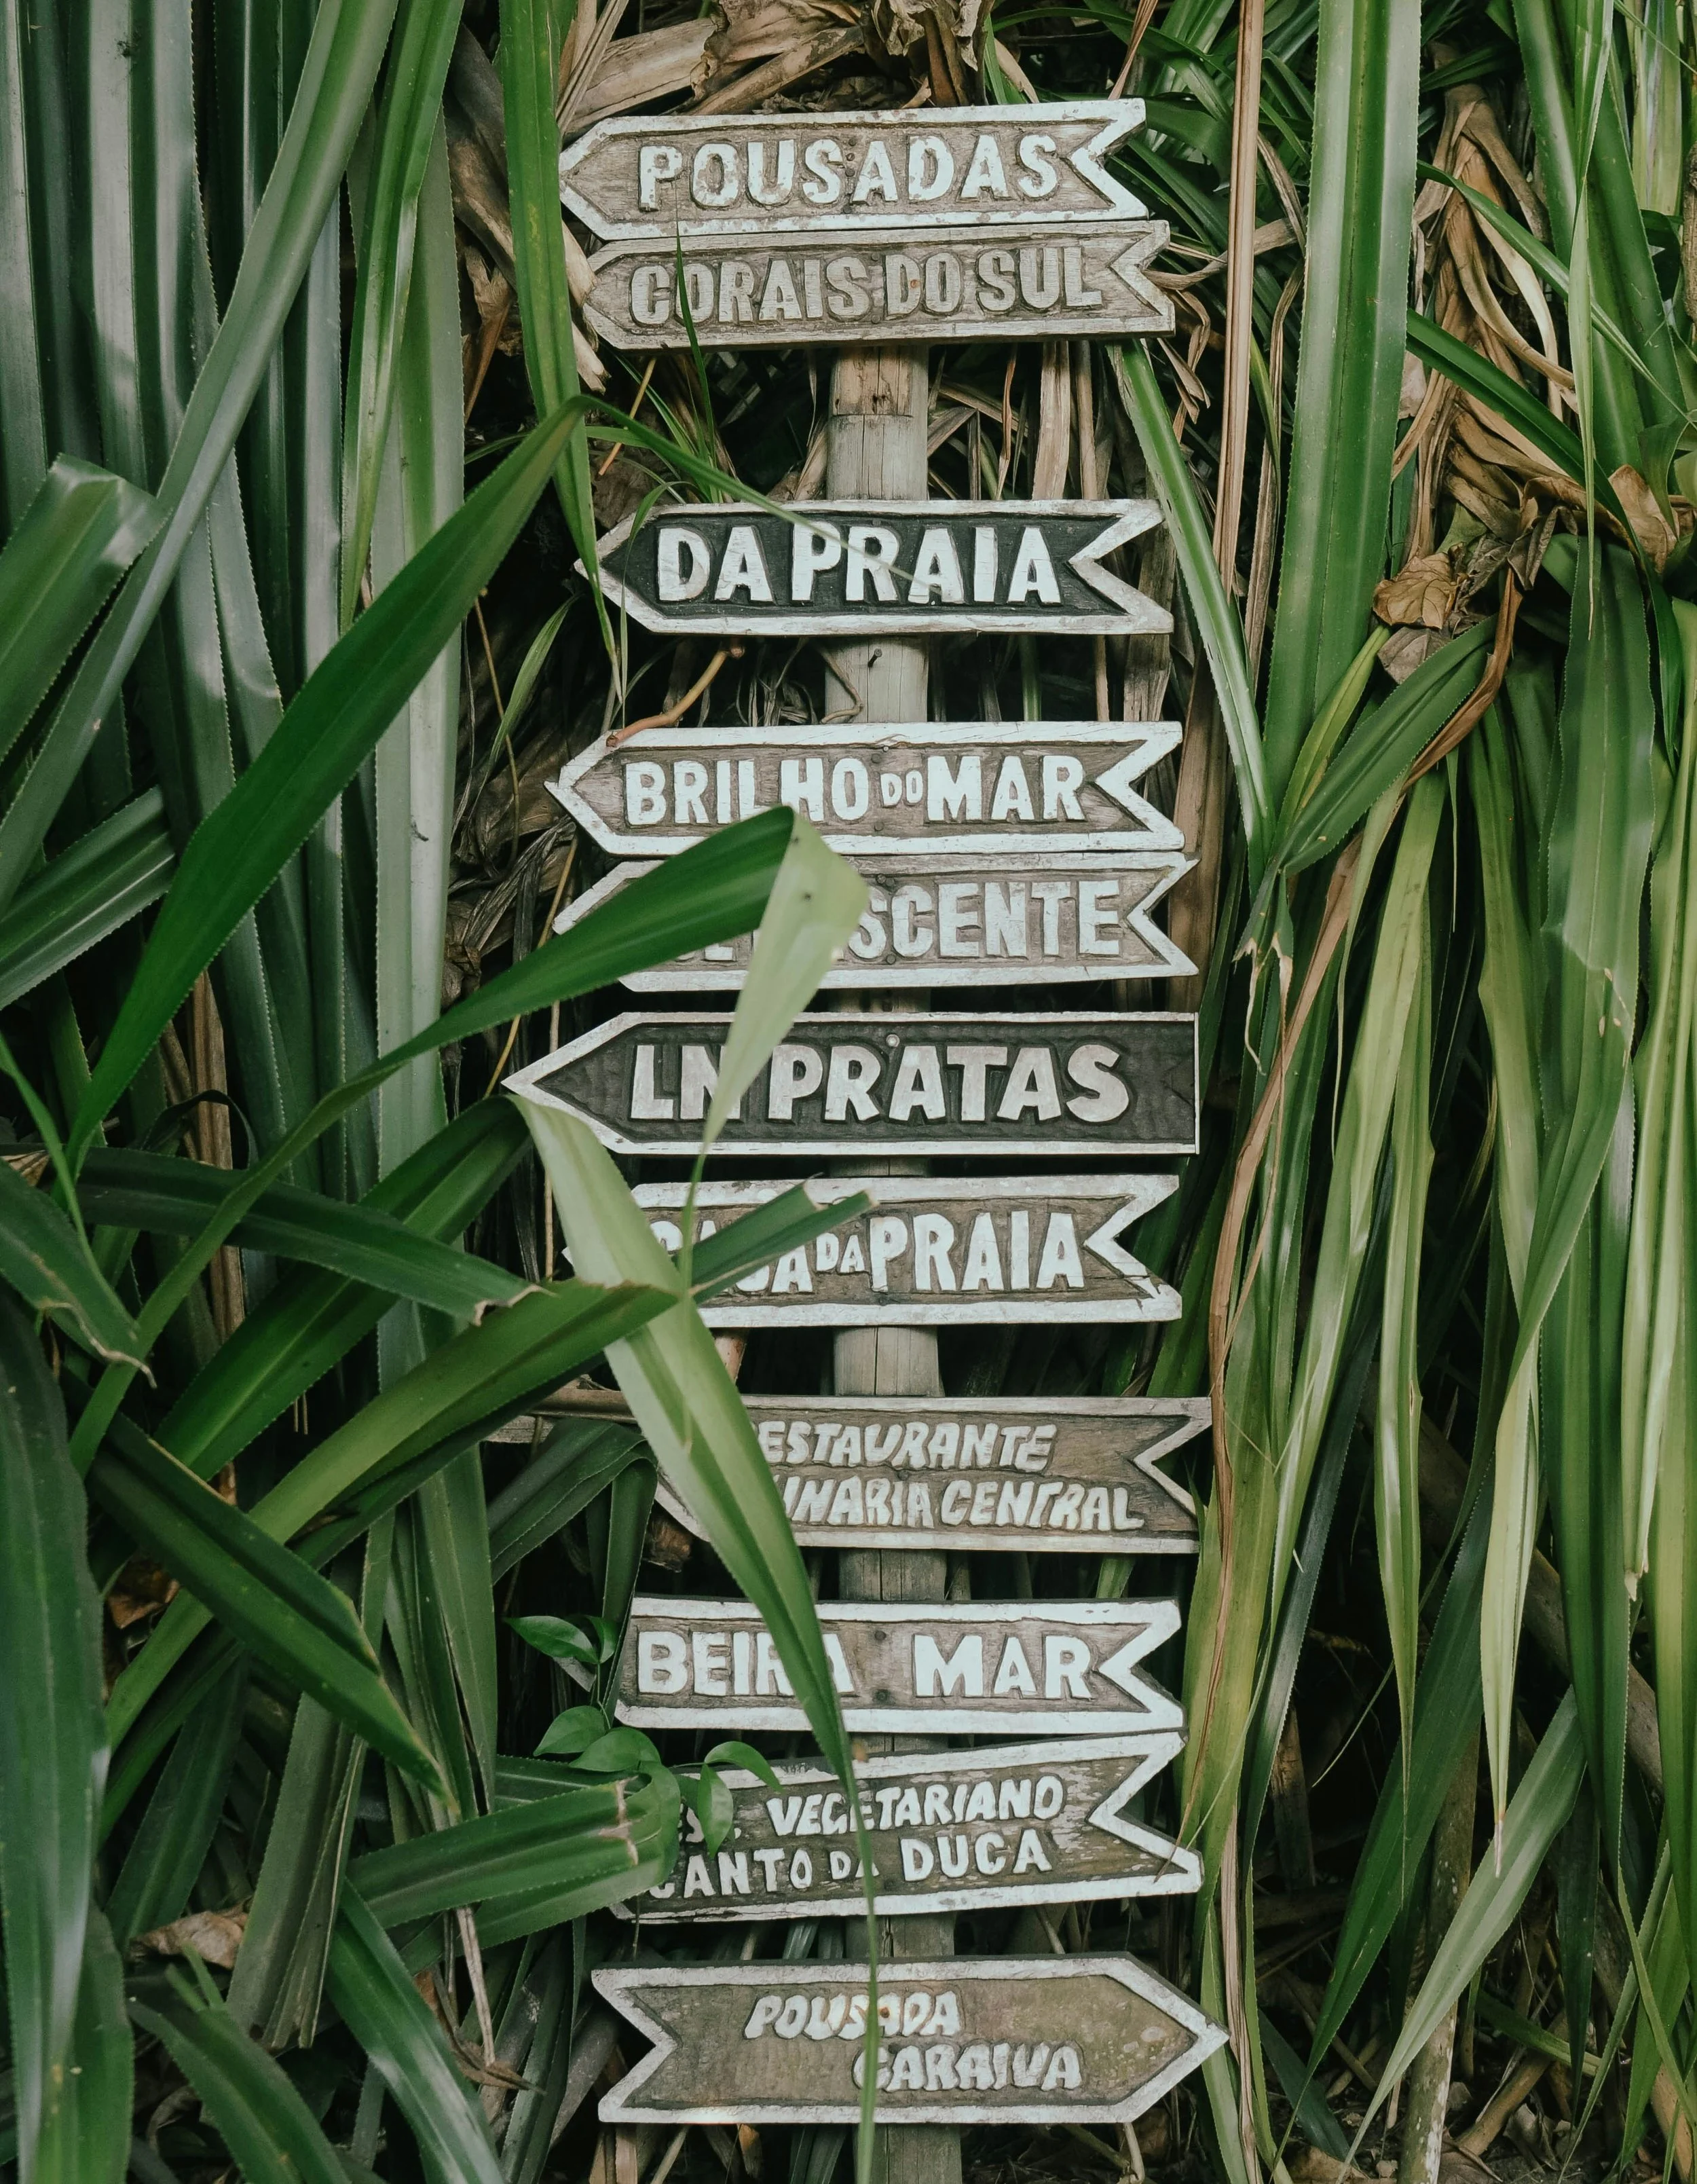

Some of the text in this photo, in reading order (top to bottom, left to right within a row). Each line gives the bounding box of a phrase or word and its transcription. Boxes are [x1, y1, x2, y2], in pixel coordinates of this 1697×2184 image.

[638, 134, 1059, 212] POUSADAS
[631, 244, 1102, 325] CORAIS DO SUL
[656, 521, 1062, 604] DA PRAIA
[625, 755, 1084, 826] BRILHO DO MAR
[753, 880, 1120, 961] SCENTE
[768, 1043, 1129, 1122] PRATAS
[816, 1232, 865, 1274] DA
[870, 1211, 1085, 1293] PRAIA
[749, 1421, 1057, 1472] ESTAURANTE
[773, 1475, 1145, 1532] INARIA CENTRAL
[914, 1634, 1092, 1699] MAR
[766, 1775, 1063, 1836] VEGETARIANO
[900, 1829, 1053, 1881] DUCA
[744, 1991, 961, 2041] POUSADA
[853, 2042, 1083, 2092] CARAIVA
